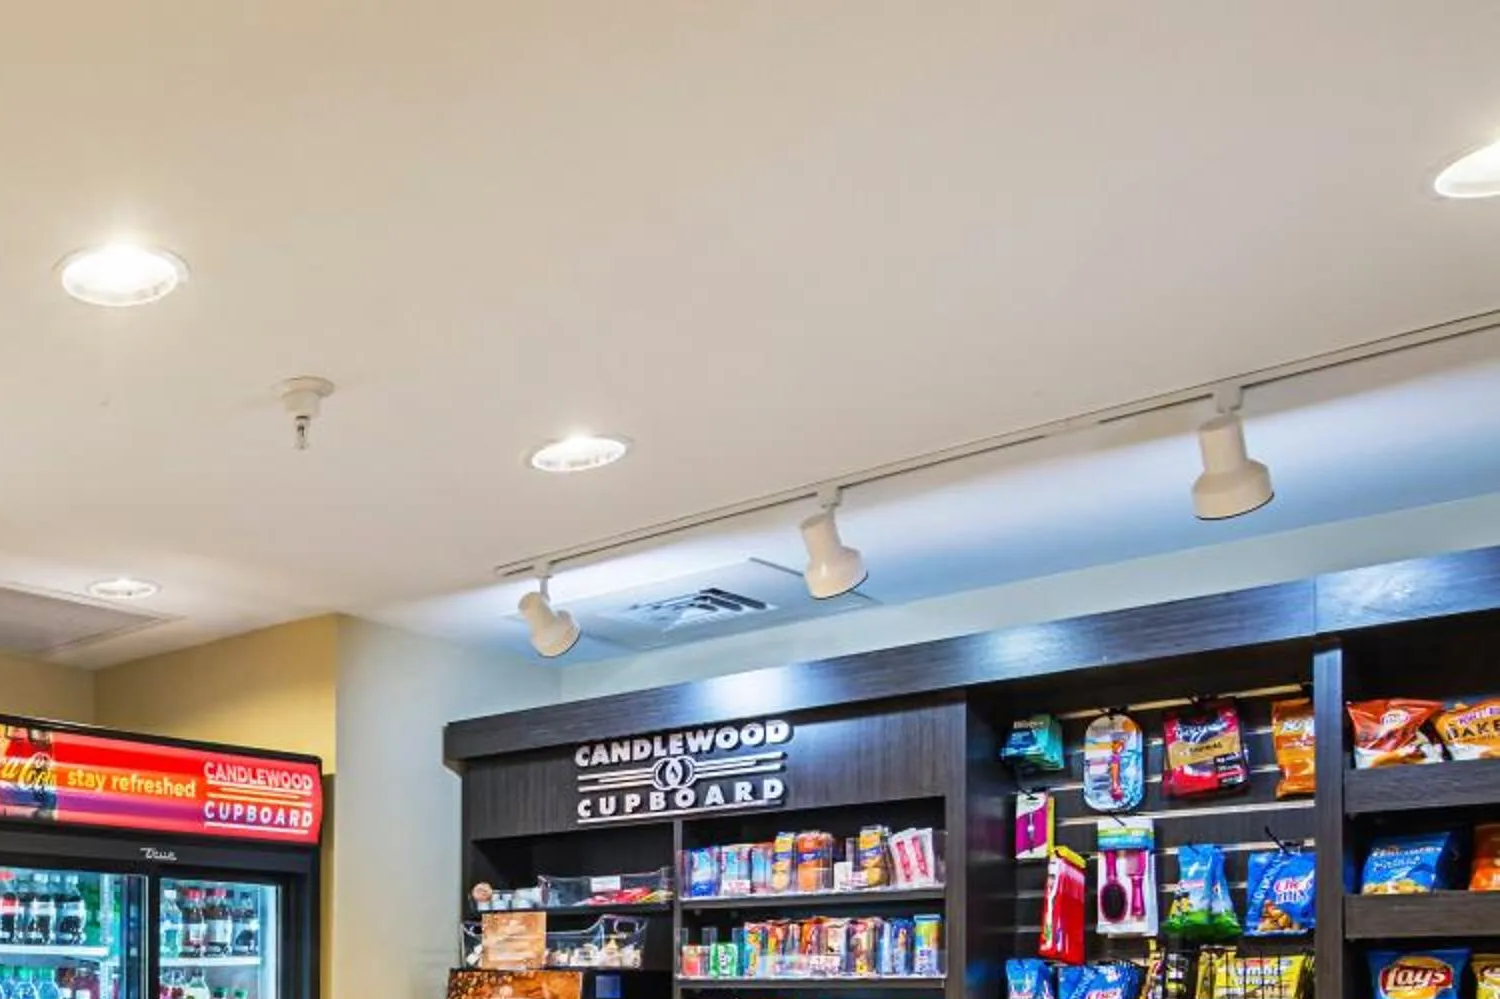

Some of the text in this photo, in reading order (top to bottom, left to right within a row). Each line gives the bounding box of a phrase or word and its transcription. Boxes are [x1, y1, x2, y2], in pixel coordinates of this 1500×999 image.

[574, 719, 791, 768] CANDLEWOOD
[67, 771, 107, 793] stay
[111, 773, 197, 799] refreshed
[204, 761, 313, 791] CANDLEWOOD
[576, 778, 785, 818] CUPBOARD
[204, 800, 313, 828] CUPBOARD
